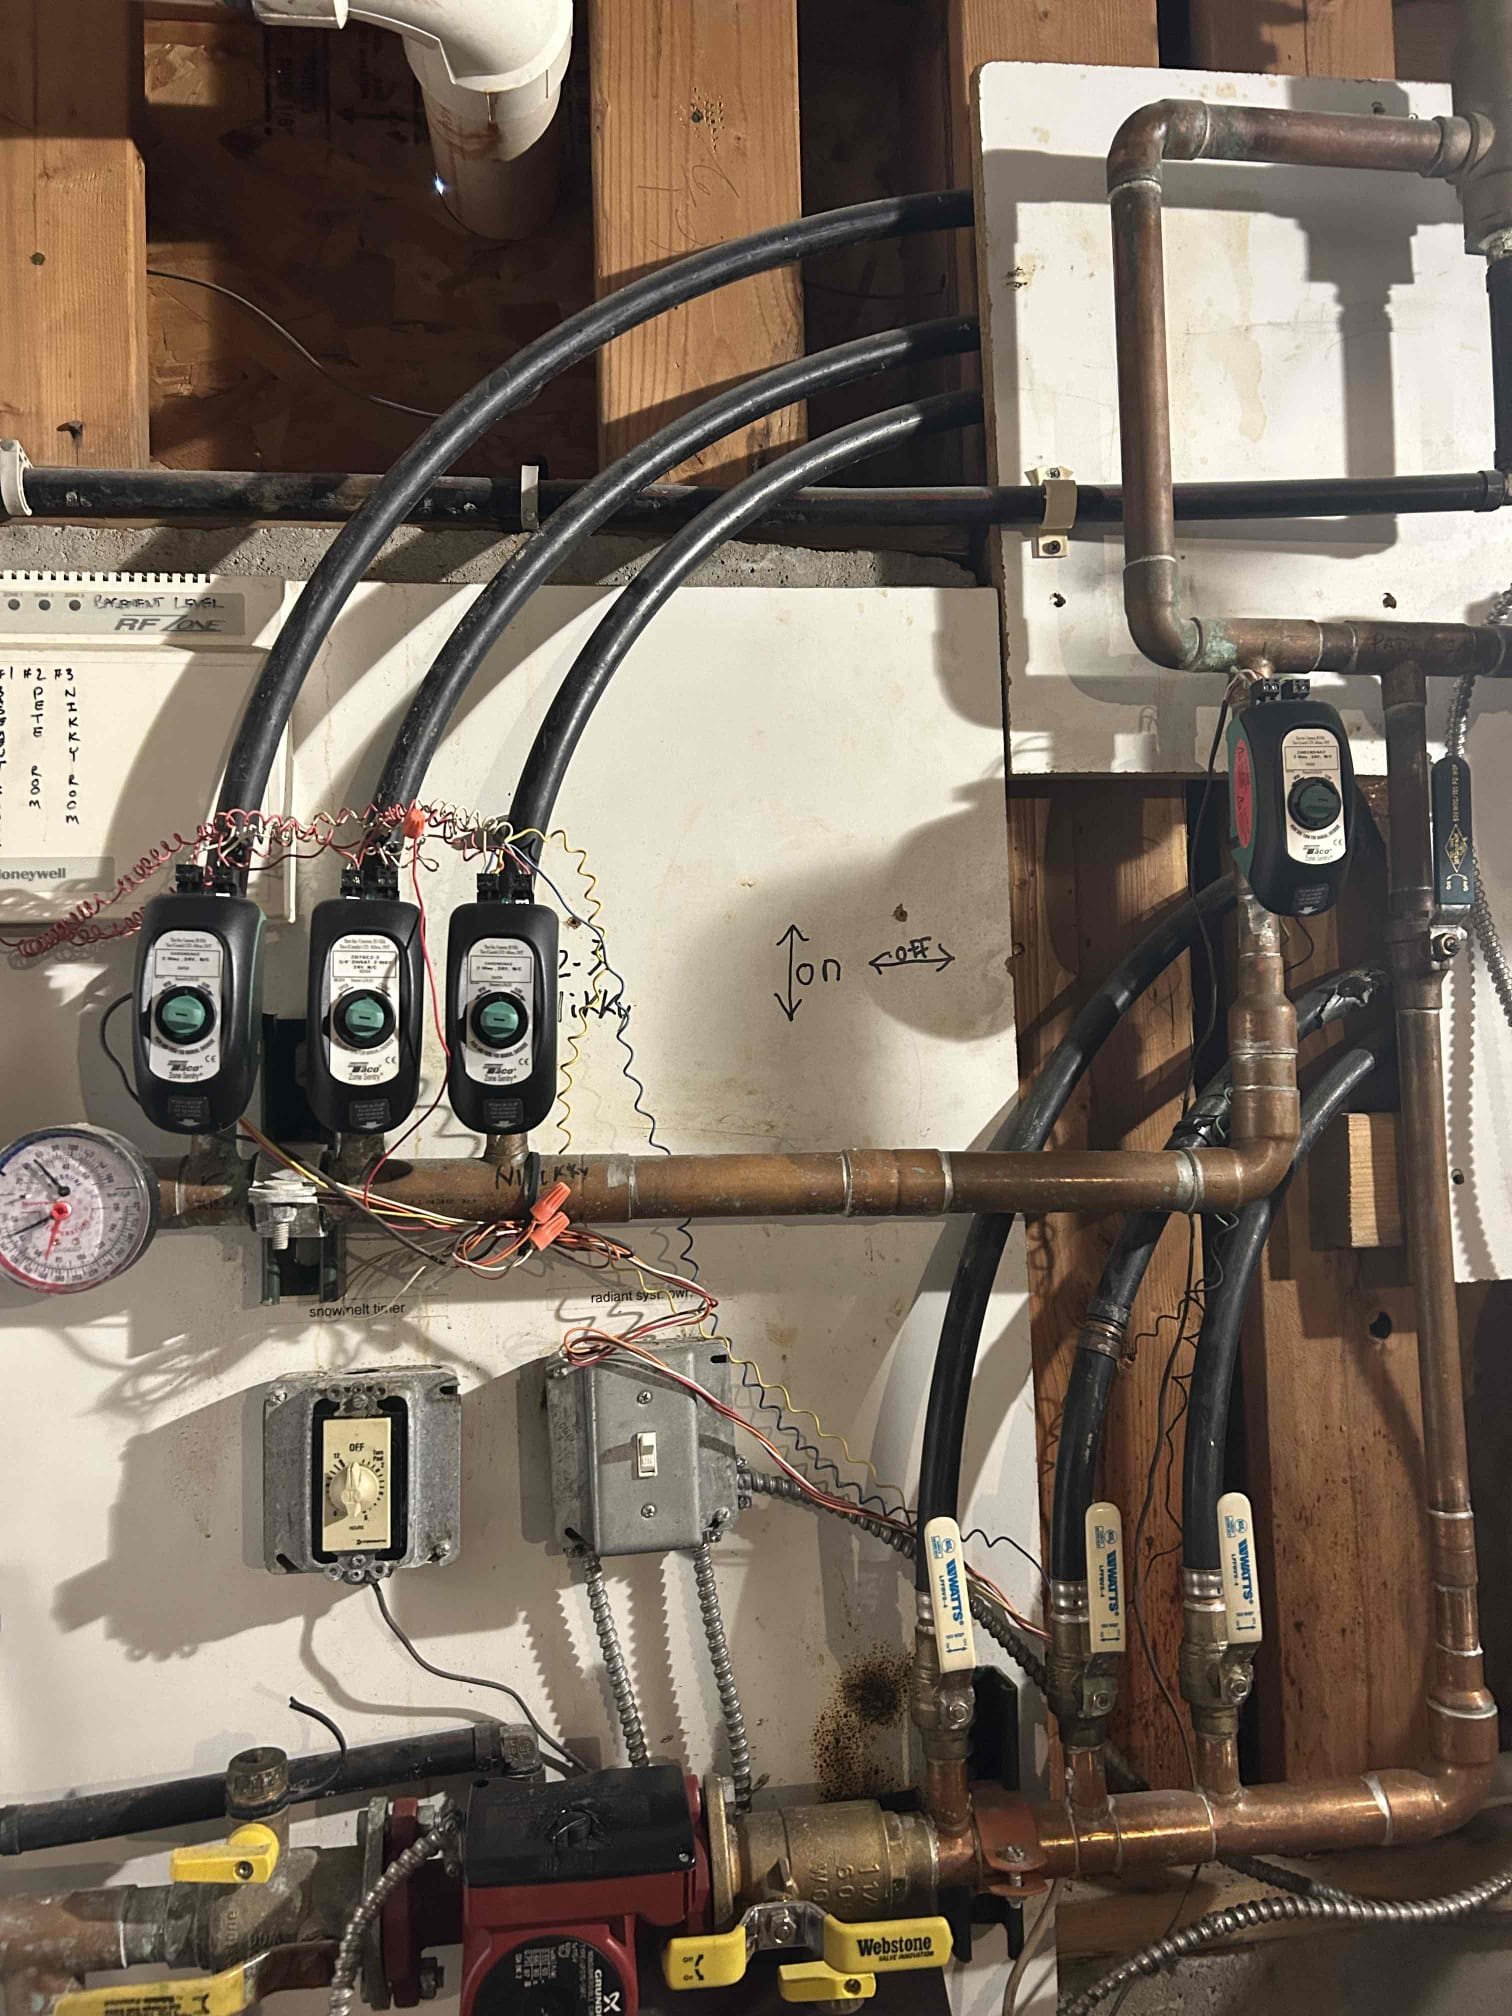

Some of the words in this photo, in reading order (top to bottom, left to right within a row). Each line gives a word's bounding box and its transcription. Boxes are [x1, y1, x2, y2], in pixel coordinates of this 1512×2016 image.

[174, 597, 225, 610] LEVEL
[23, 667, 46, 681] #2
[54, 668, 74, 681] #3
[30, 686, 45, 737] PETE
[0, 867, 66, 882] oneywell
[795, 958, 842, 986] on
[590, 1290, 632, 1304] radiant
[349, 1443, 365, 1452] OFF
[1238, 1538, 1253, 1602] WATTS
[946, 1558, 964, 1623] WATTS
[1106, 1550, 1120, 1613] WATTS
[856, 1935, 932, 1957] Webstone
[594, 1968, 603, 2016] GRUND
